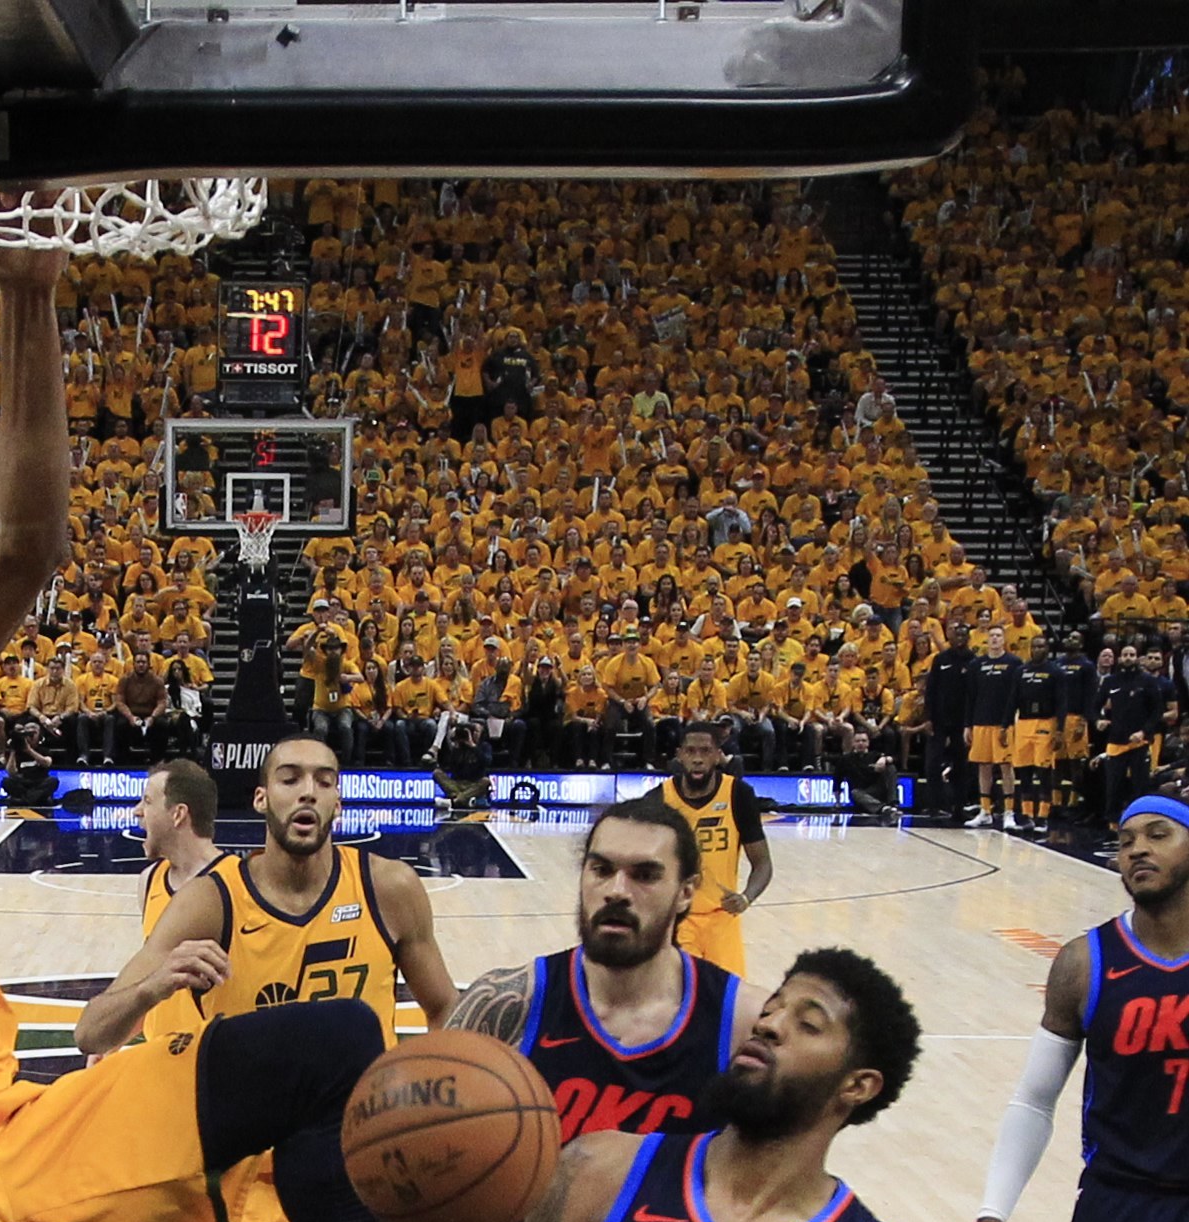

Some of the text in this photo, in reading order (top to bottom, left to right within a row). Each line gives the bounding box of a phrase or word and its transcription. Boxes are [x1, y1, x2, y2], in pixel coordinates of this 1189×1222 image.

[246, 289, 294, 311] 7:47
[250, 315, 289, 355] 12
[244, 363, 298, 374] TISSOT
[225, 743, 275, 769] PLAYO
[93, 772, 149, 797] NBAStor
[342, 774, 434, 799] NBAStore.com
[697, 828, 728, 852] 23
[309, 964, 369, 1000] 27
[1164, 1058, 1189, 1115] 7
[349, 1075, 458, 1127] ALDING
